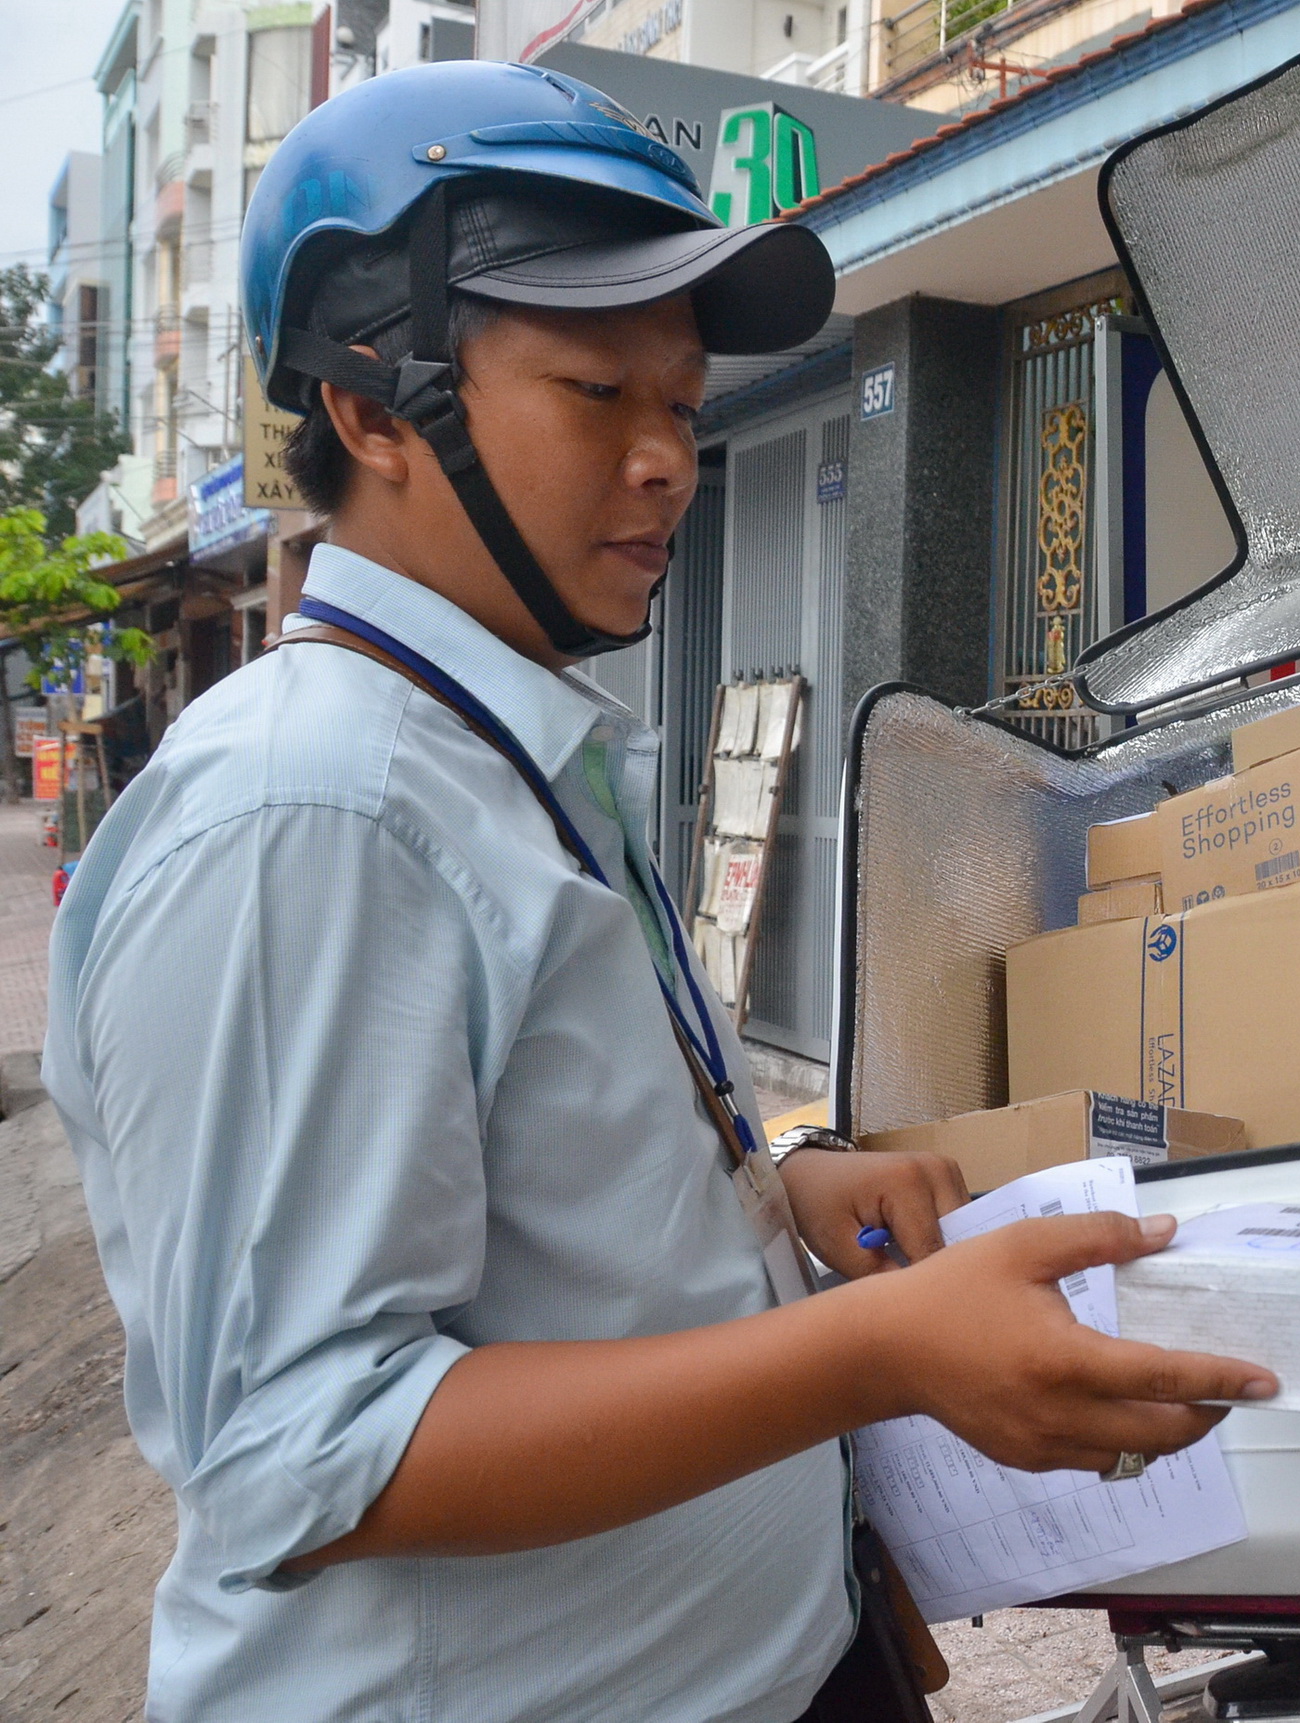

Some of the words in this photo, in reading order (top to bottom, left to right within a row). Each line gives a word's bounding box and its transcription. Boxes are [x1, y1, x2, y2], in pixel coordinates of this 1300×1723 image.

[863, 369, 893, 413] 557
[818, 462, 843, 487] 555
[1182, 782, 1291, 837] Effortless
[1183, 805, 1295, 859] Shopping
[1275, 875, 1284, 884] 15
